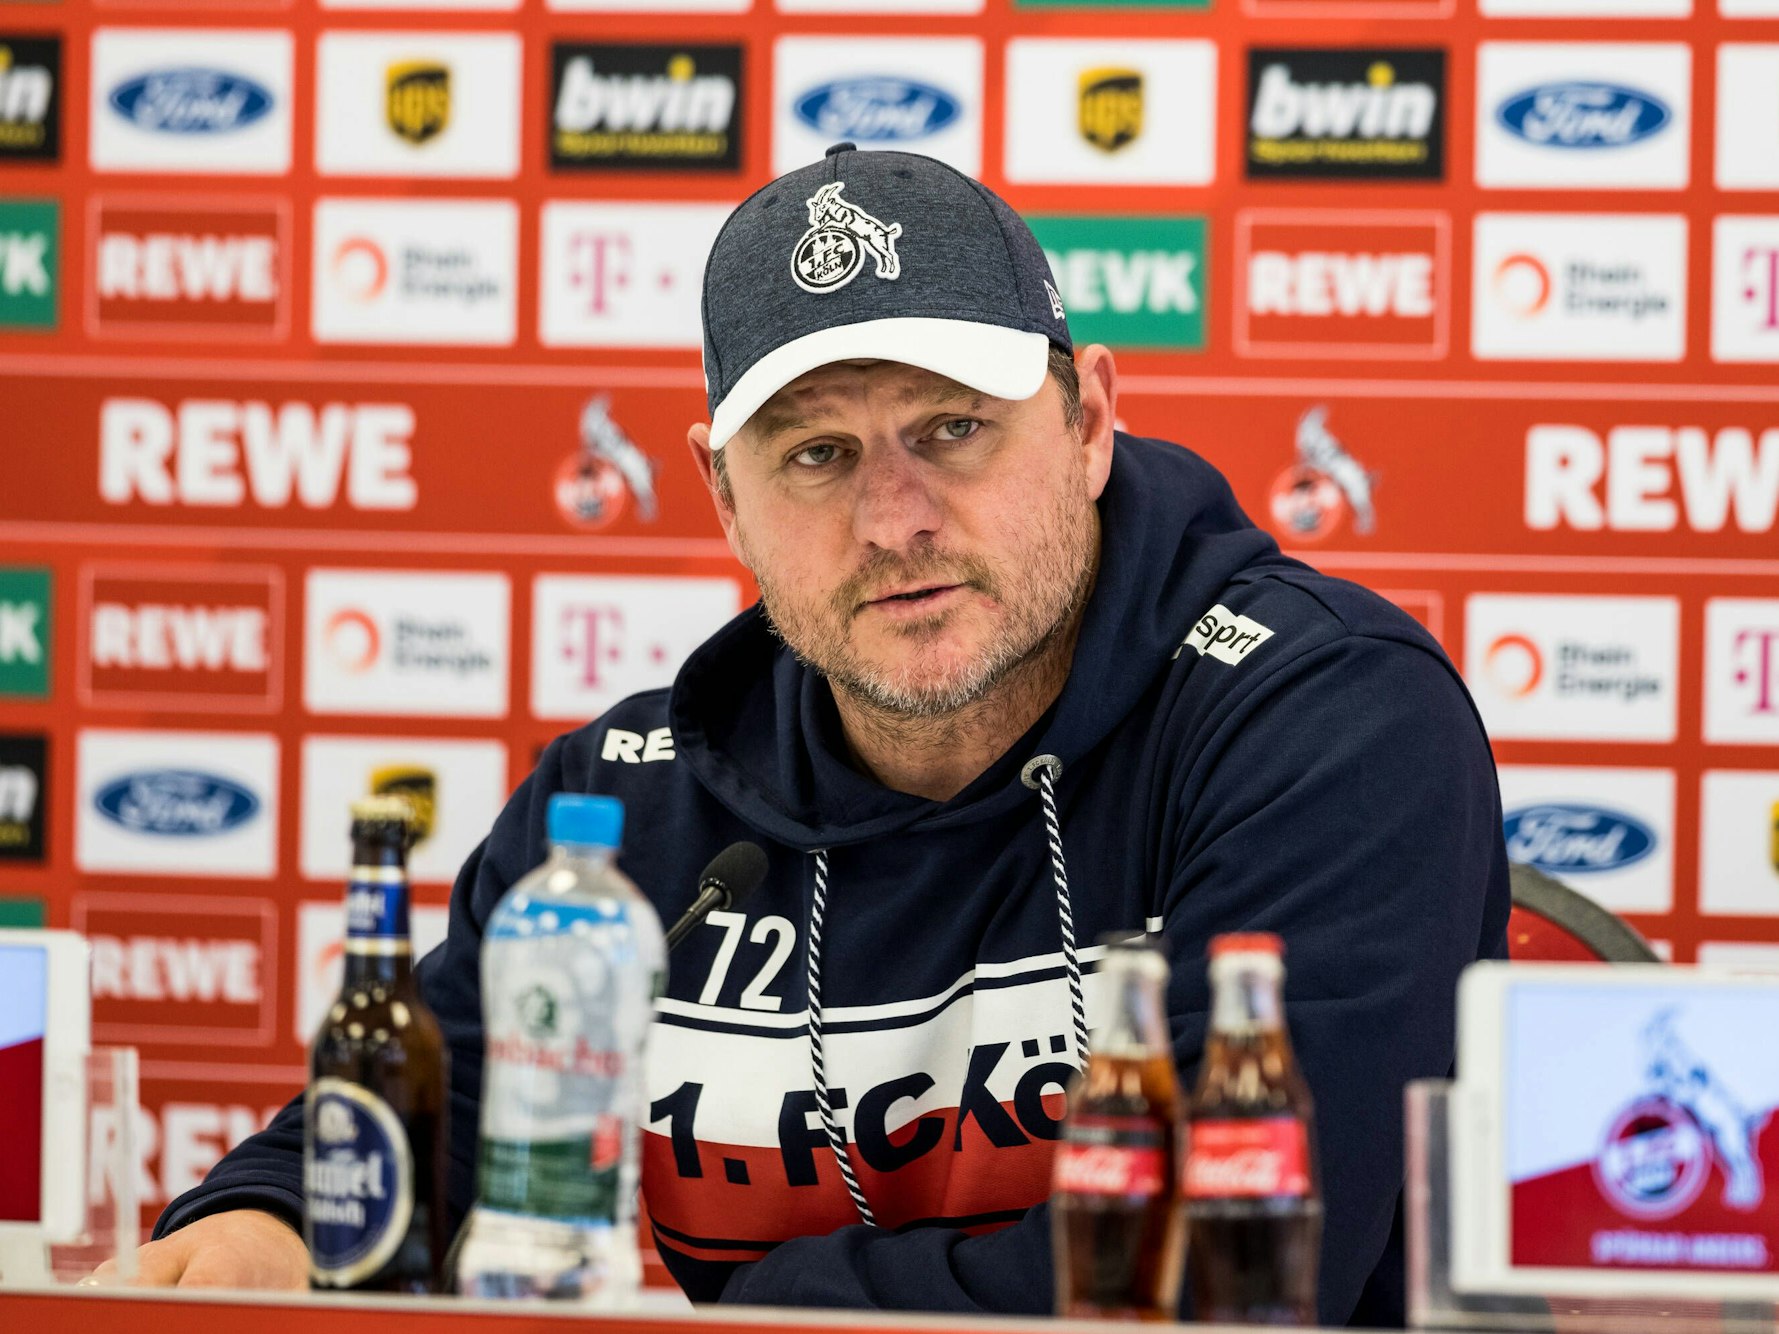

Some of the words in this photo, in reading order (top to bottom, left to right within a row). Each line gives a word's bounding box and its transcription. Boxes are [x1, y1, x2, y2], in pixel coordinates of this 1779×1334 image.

[555, 54, 735, 131] bwin
[819, 80, 934, 138] Ford
[1252, 61, 1437, 138] bwin
[1522, 85, 1643, 145] Ford
[98, 233, 276, 301] REWE
[816, 262, 842, 279] KÖLN
[1248, 250, 1433, 319] REWE
[100, 397, 417, 511] REWE
[1524, 424, 1779, 533] REW
[91, 603, 270, 672] REWE
[1195, 614, 1261, 654] sprt
[601, 727, 676, 764] RE
[1505, 806, 1628, 868] Ford
[88, 934, 262, 1003] REWE
[699, 910, 797, 1012] 72
[778, 1072, 945, 1187] FC
